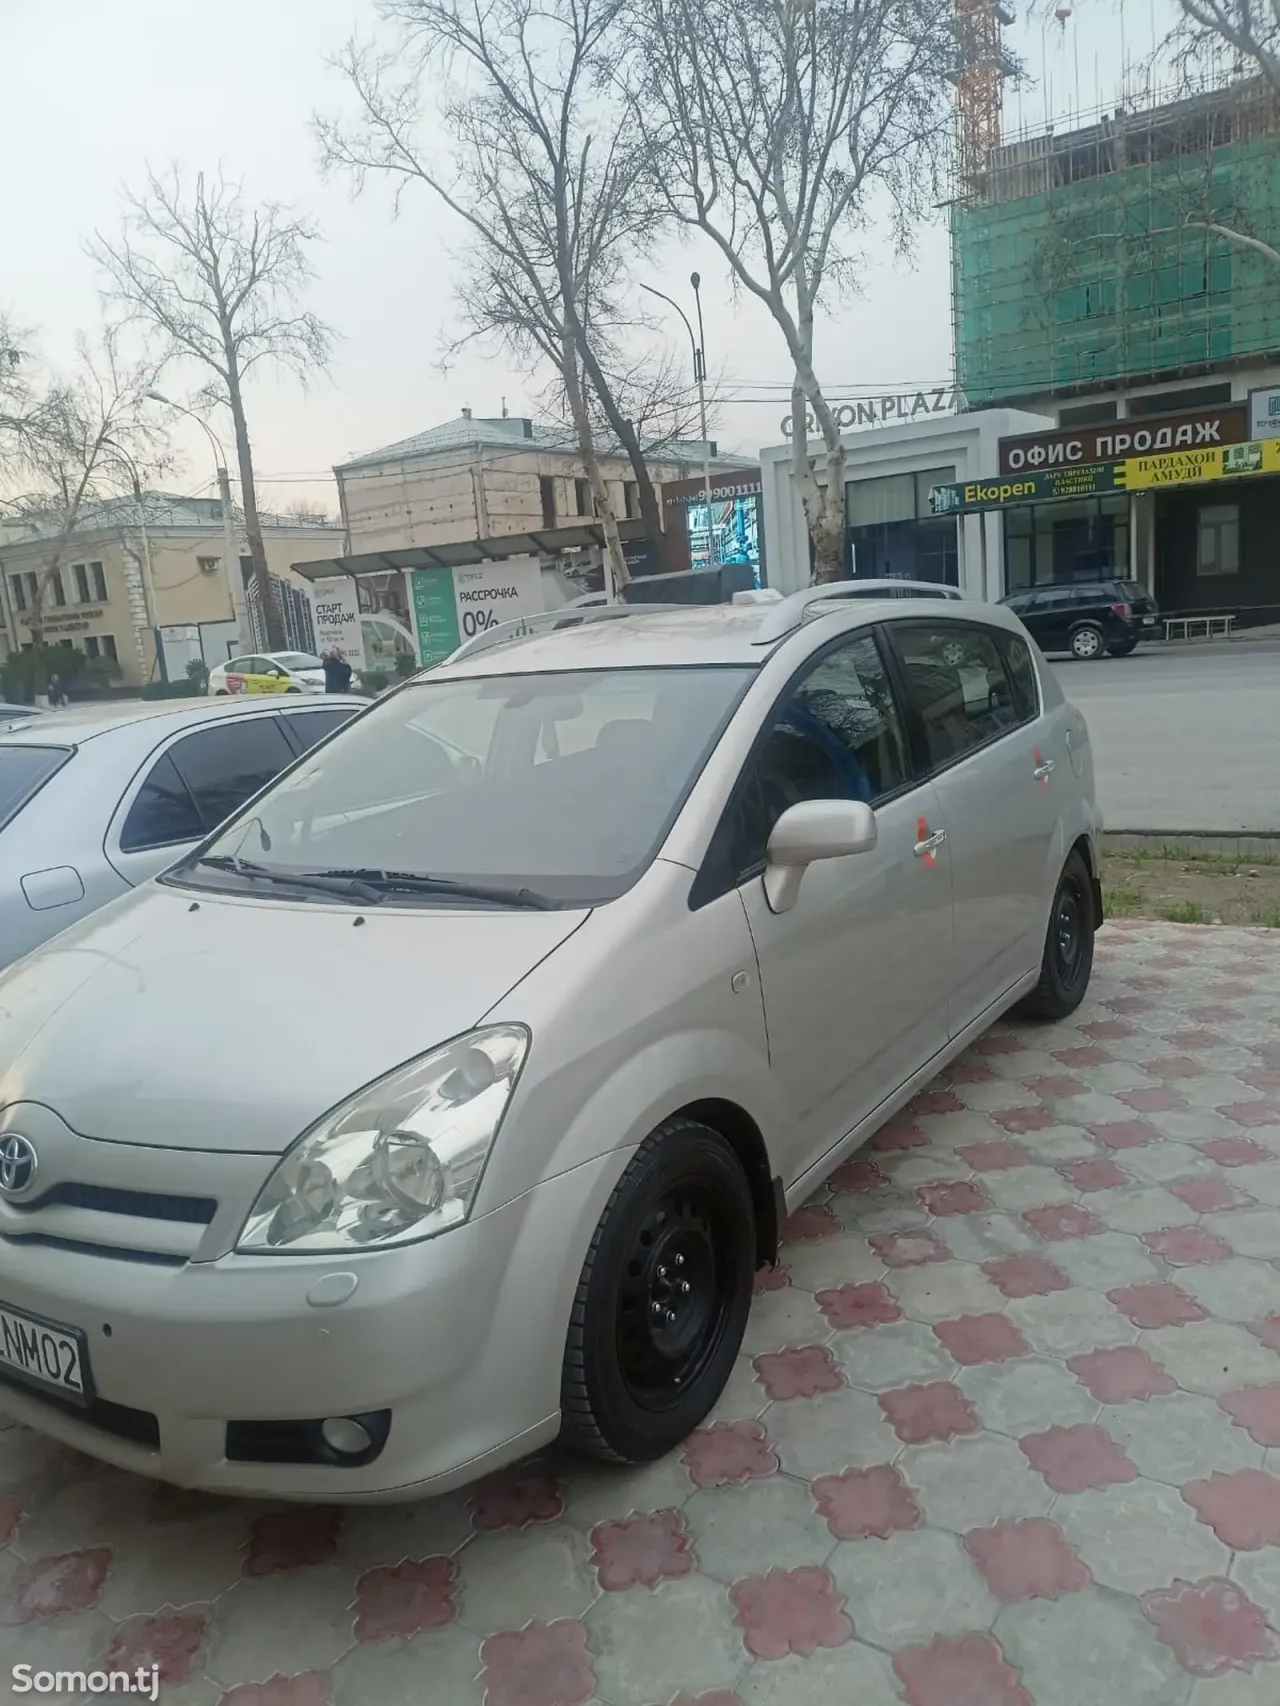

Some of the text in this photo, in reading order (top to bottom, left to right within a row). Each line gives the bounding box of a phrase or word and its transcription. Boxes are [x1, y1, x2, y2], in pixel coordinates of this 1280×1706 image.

[881, 386, 969, 421] PLAZA
[1008, 420, 1220, 469] ОФИС ПРОДАЖ
[964, 481, 1036, 502] Ekopen
[460, 586, 519, 603] РАССРОЧКА
[315, 602, 342, 615] СТАРТ
[317, 612, 356, 626] ПРОДАЖ
[463, 609, 499, 637] 0%
[0, 1315, 81, 1389] NM02
